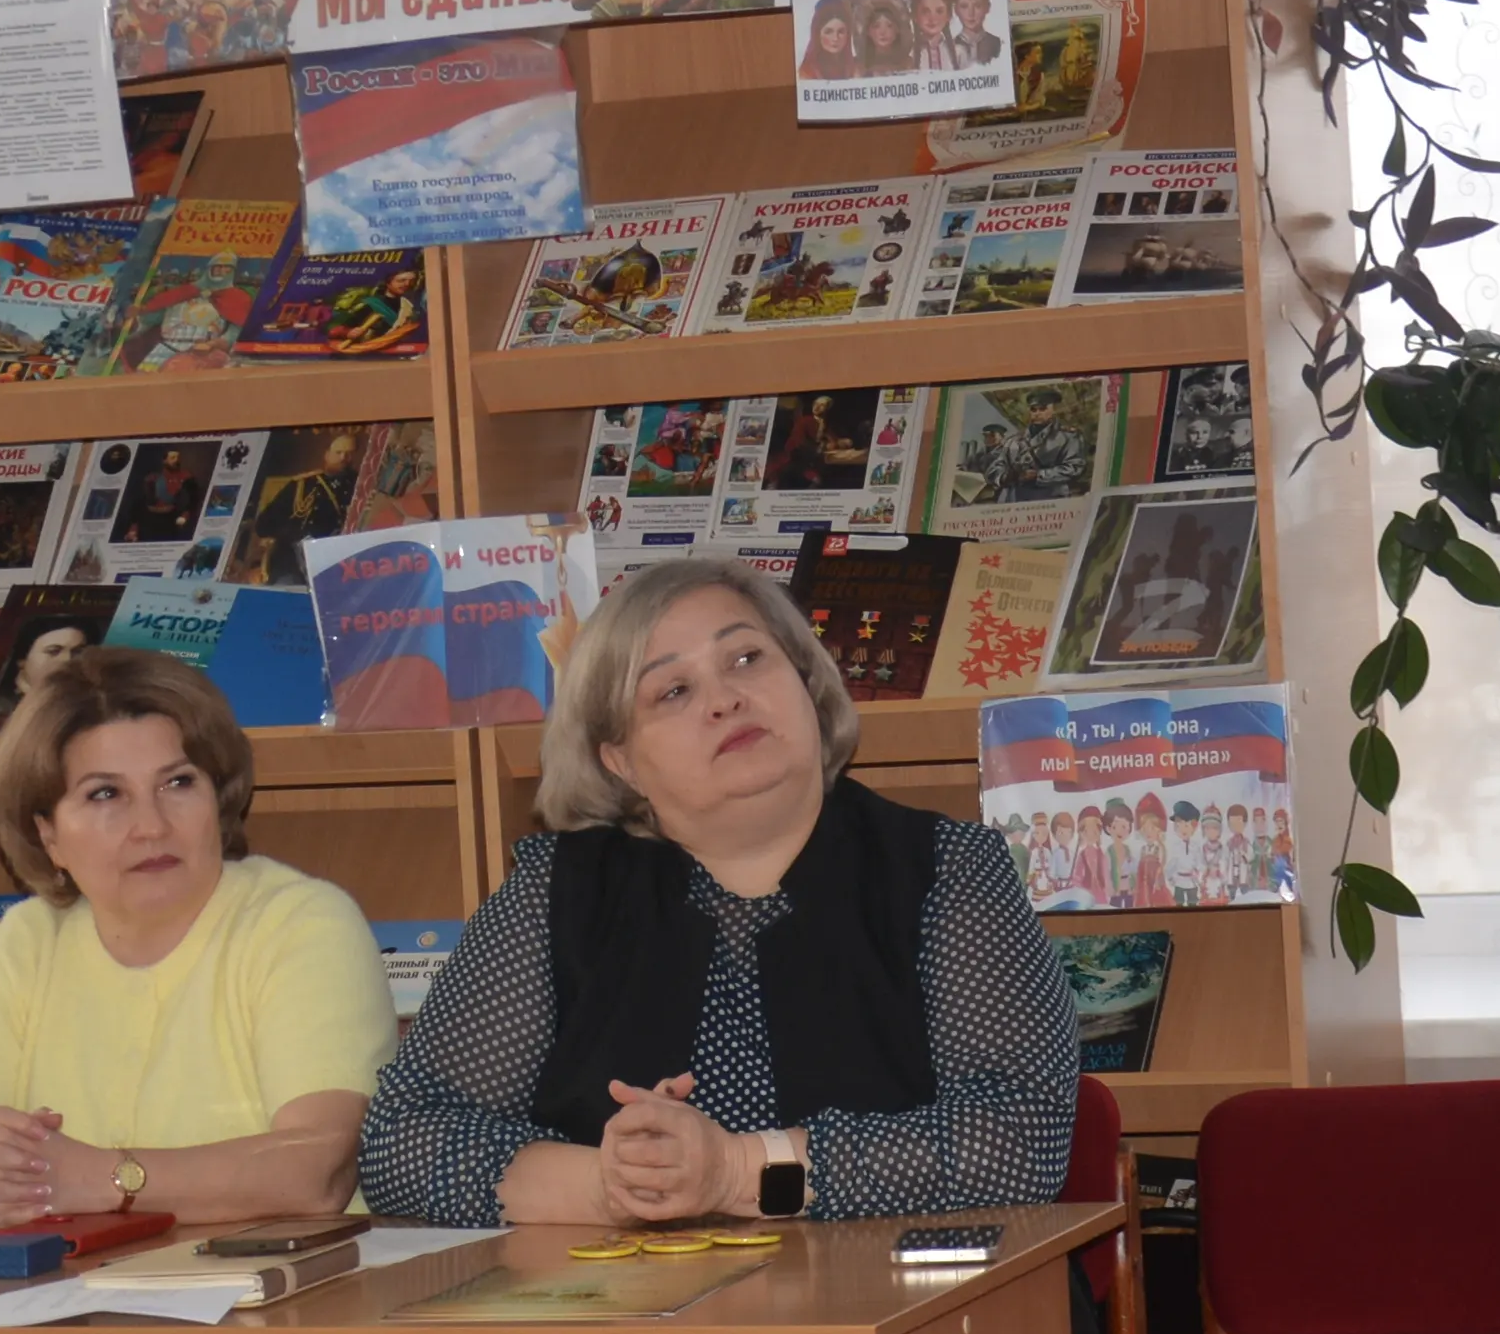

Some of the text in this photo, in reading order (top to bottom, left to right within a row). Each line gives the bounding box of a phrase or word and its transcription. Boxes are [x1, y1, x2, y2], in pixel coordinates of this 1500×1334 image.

[438, 62, 490, 83] это
[803, 90, 811, 102] В
[813, 86, 868, 102] ЕДИНСТВЕ
[870, 83, 919, 99] НАРОДОВ
[928, 79, 956, 94] СИЛА
[958, 75, 1000, 92] РОССИИ!
[1151, 177, 1218, 190] ФЛОТ
[755, 194, 909, 218] КУЛИКОВСКАЯ
[987, 202, 1071, 218] ИСТОРИЯ
[793, 211, 859, 230] БИТВА
[1009, 516, 1018, 525] О
[339, 543, 556, 583] Хвала и честь
[340, 606, 444, 636] героям
[451, 589, 568, 629] страны!
[1055, 720, 1077, 740] «Я
[1091, 724, 1116, 739] ты
[1129, 722, 1153, 737] он
[1166, 718, 1199, 735] она
[1040, 757, 1071, 772] мы
[1089, 753, 1155, 773] единая
[1159, 749, 1232, 771] страна»
